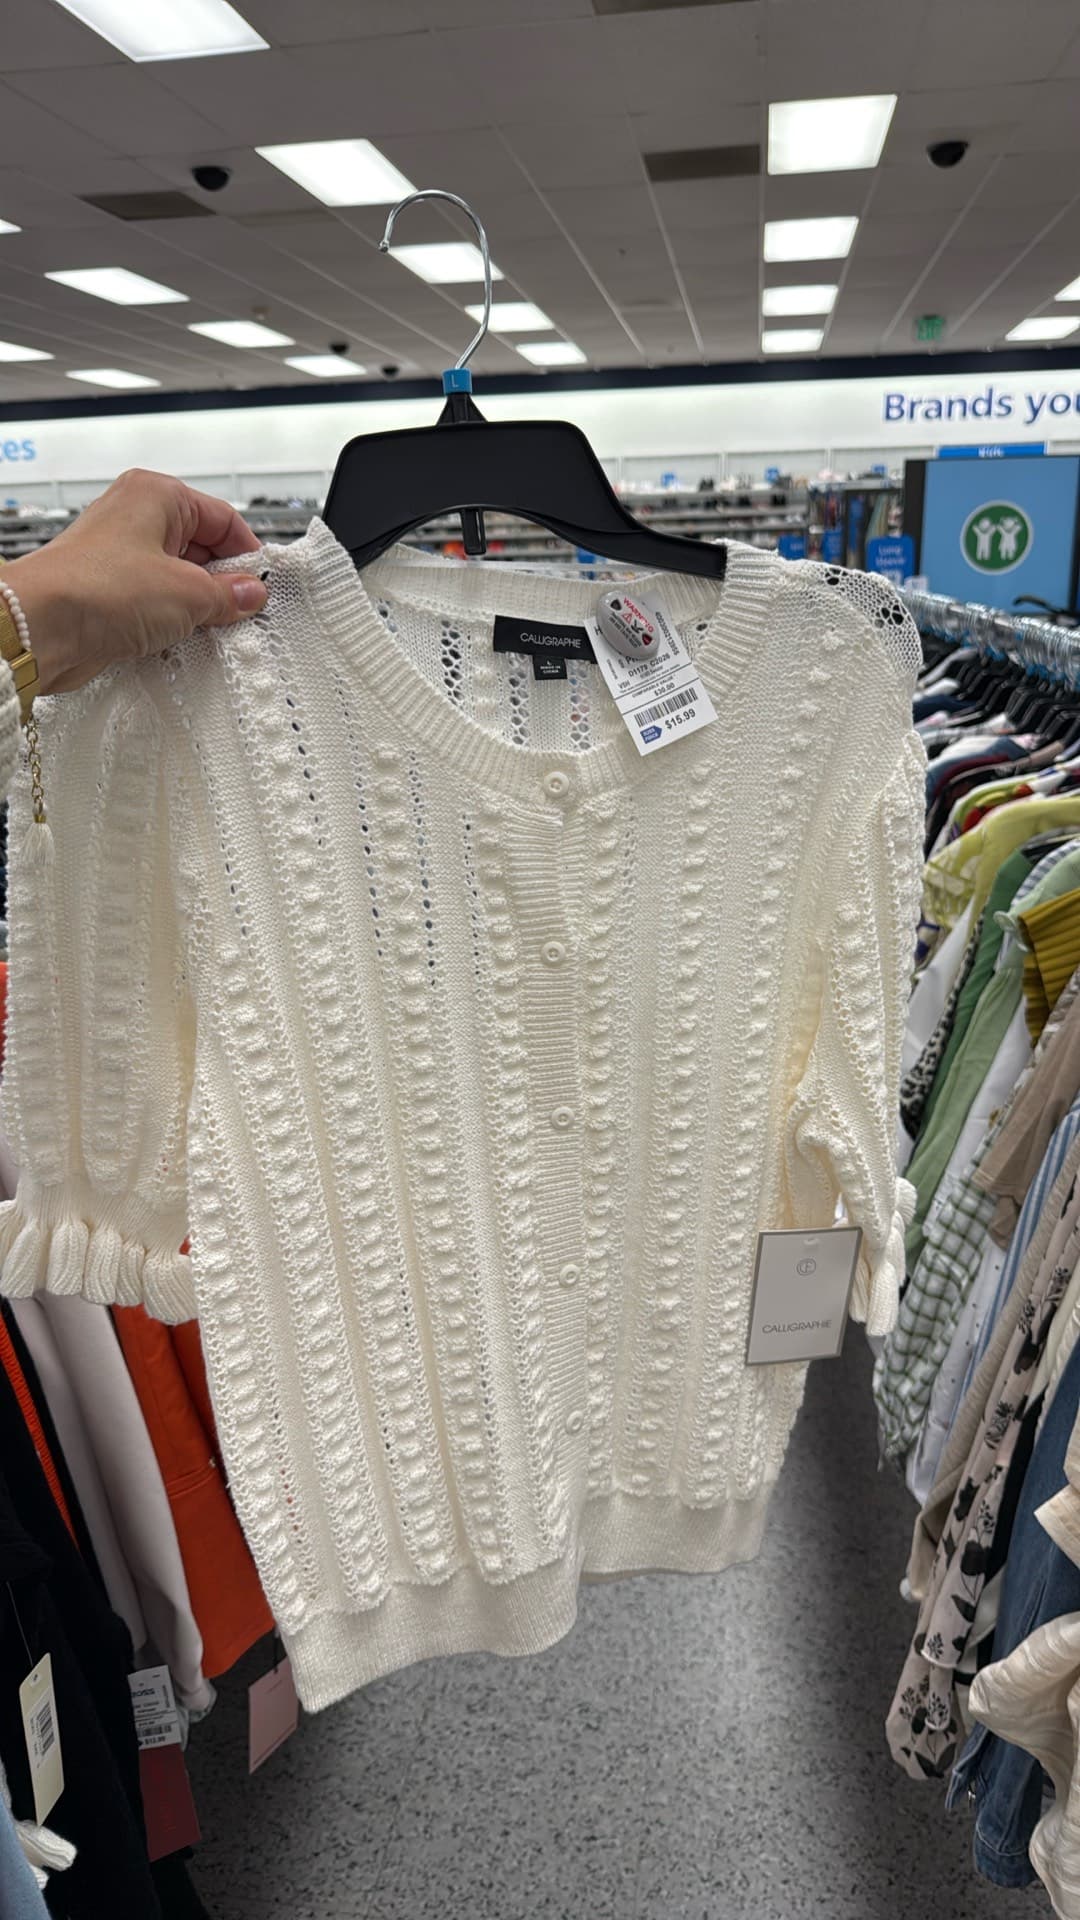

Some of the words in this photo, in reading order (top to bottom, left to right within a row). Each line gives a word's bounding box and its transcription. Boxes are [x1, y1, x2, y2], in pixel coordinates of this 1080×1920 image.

[451, 374, 459, 388] L
[884, 387, 1013, 421] Brands
[0, 440, 37, 462] es
[624, 597, 655, 633] WARNING
[664, 708, 696, 731] $15.99
